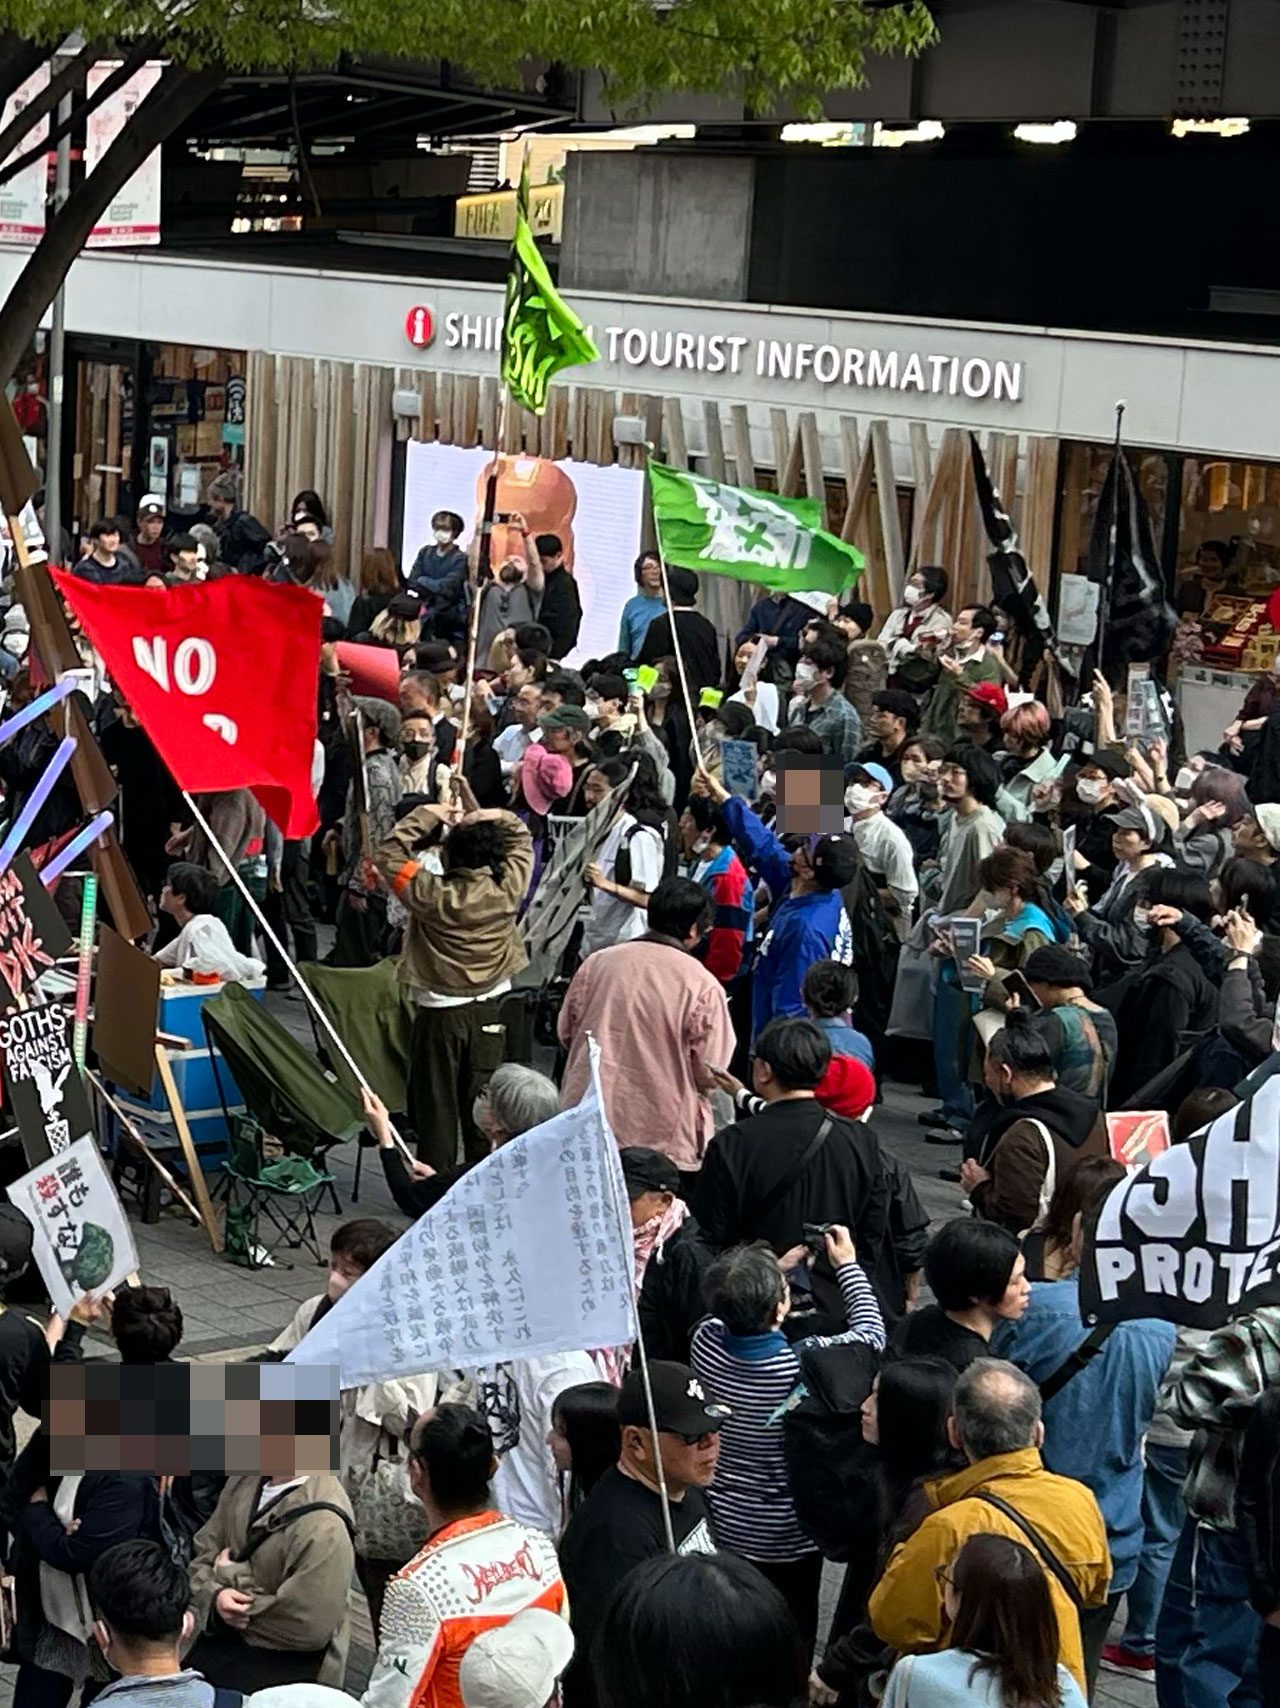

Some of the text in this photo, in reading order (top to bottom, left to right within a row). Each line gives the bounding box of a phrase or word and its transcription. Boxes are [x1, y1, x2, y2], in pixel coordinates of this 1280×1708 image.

[605, 327, 746, 373] TOURIST
[757, 340, 1021, 400] INFORMATION
[6, 1030, 65, 1066] AGAINST
[35, 1173, 79, 1250] 殺すな
[56, 1157, 90, 1208] 誰も
[1096, 1243, 1280, 1305] PROTE
